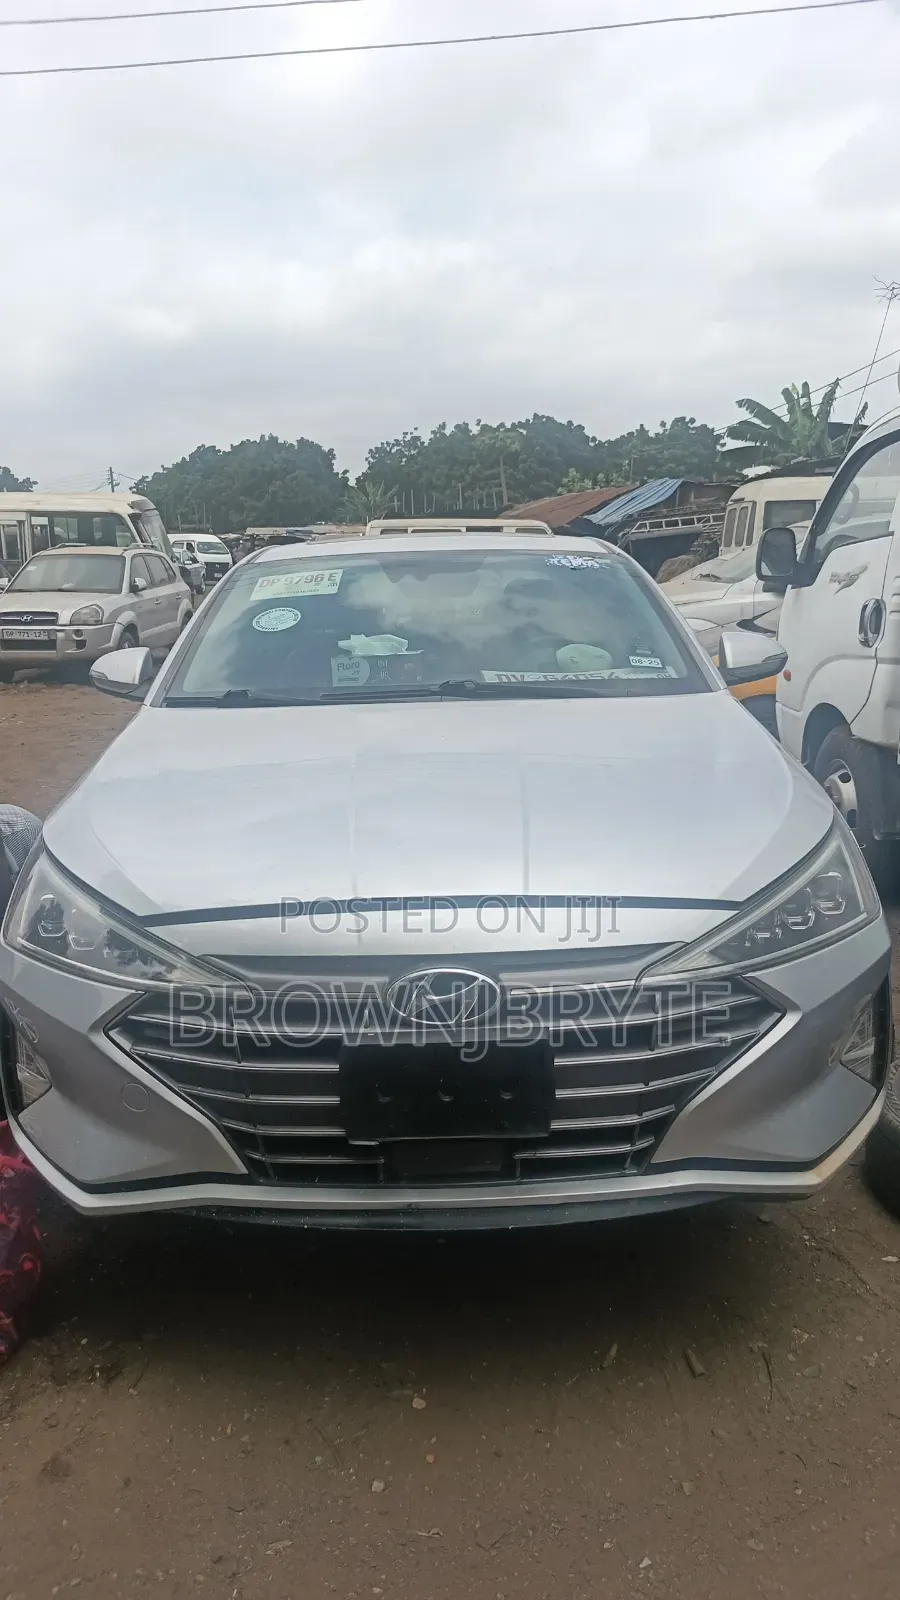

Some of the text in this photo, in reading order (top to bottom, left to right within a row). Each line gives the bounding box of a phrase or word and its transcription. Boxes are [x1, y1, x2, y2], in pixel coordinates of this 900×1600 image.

[259, 579, 280, 588] DP
[284, 573, 325, 586] 9796
[327, 572, 338, 582] E
[337, 661, 360, 672] Flora
[631, 658, 660, 666] 08-25
